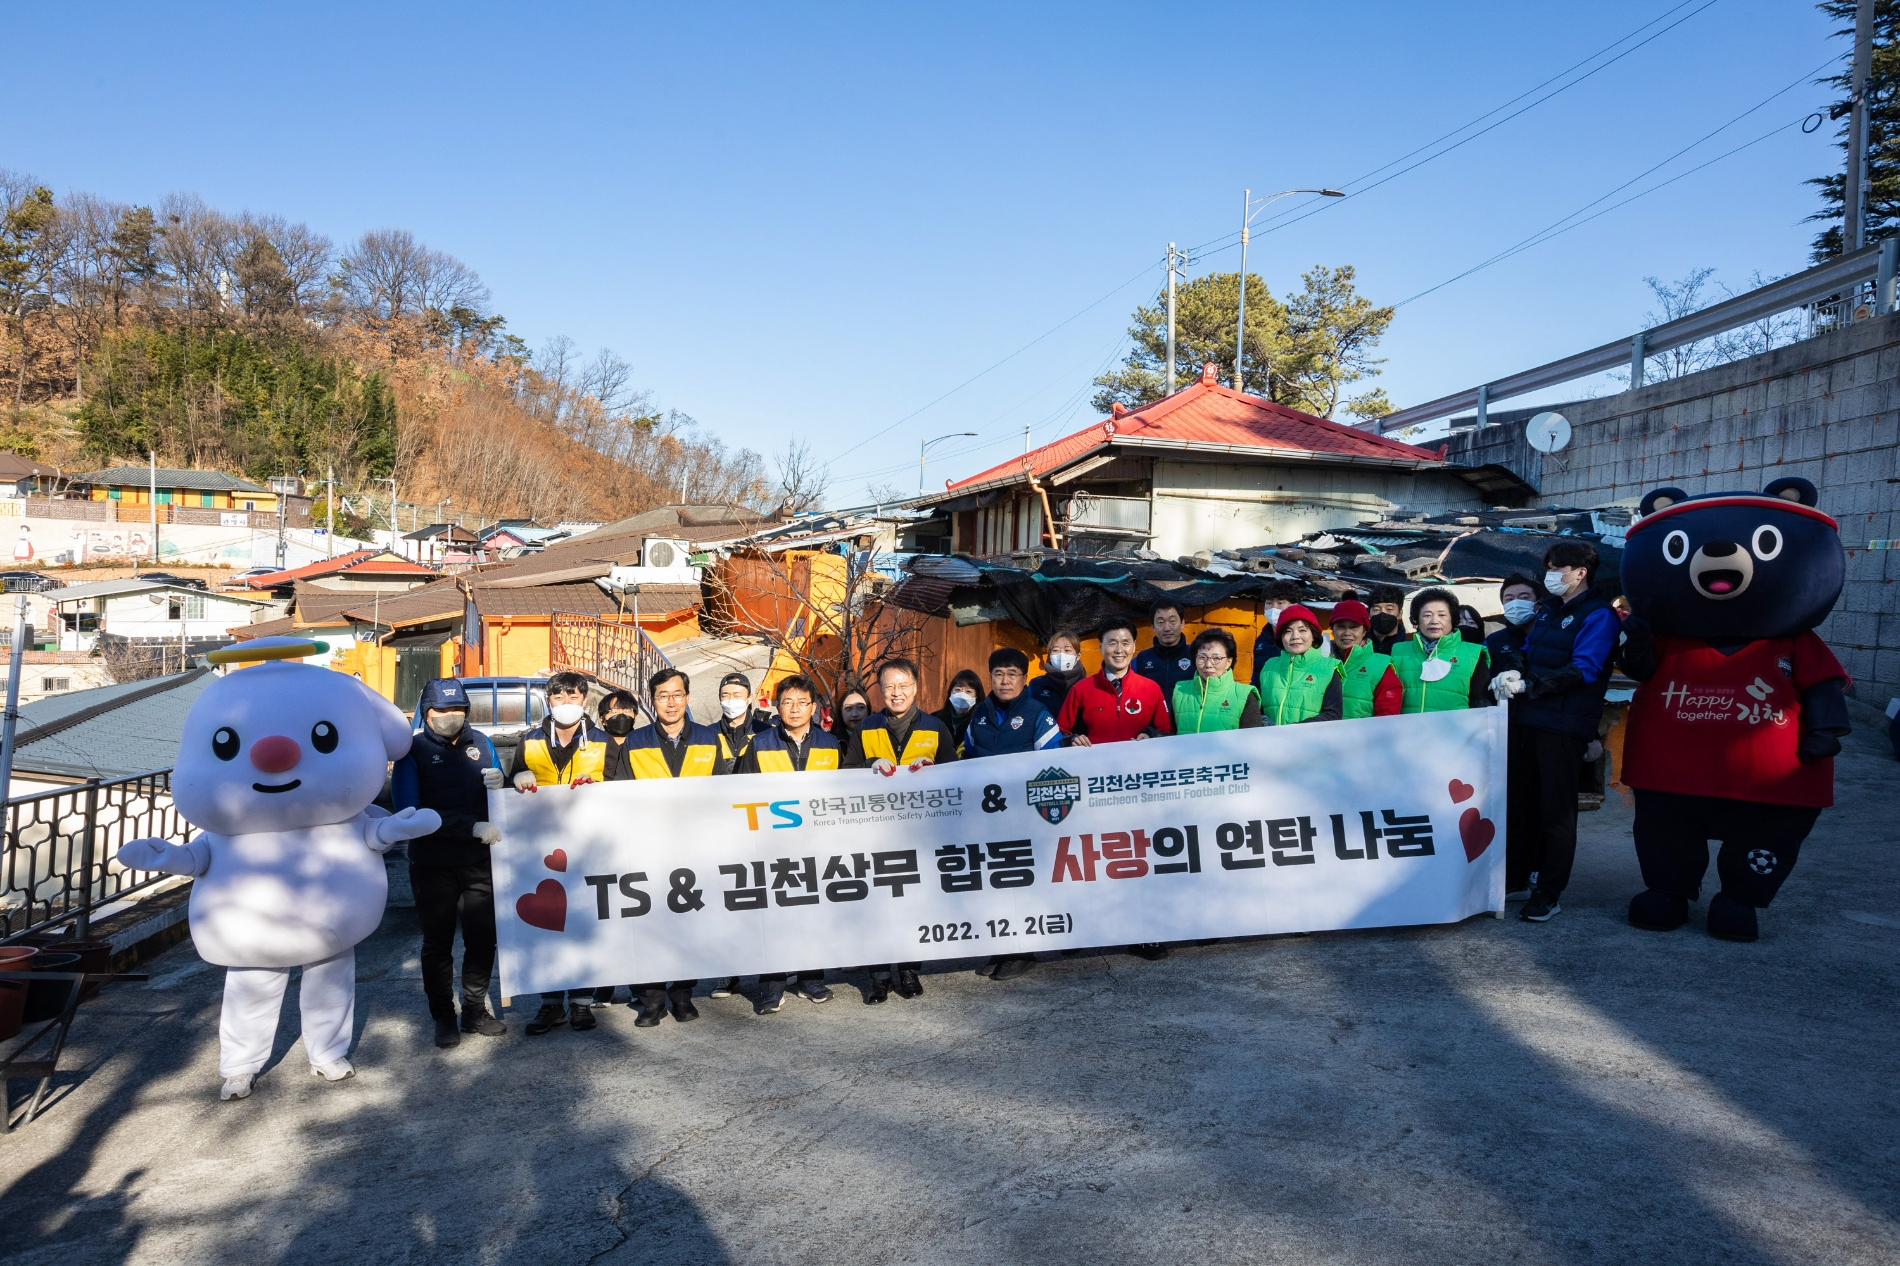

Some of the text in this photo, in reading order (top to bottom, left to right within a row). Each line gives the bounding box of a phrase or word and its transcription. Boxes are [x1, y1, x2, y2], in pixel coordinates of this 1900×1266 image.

[1661, 681, 1734, 710] Happy
[1676, 702, 1788, 725] together 김천
[732, 762, 1250, 831] TS 한국교통안전공단 & 김천상무프로축구단
[1028, 784, 1080, 805] 김천상무
[1088, 782, 1250, 808] Gimcheon Sangmu Football Club
[813, 807, 963, 827] Korea Transportation Safety Authority
[584, 808, 1436, 921] TS & 김천상무 합동 사랑의 연탄 나눔
[918, 912, 1073, 944] 2022. 12. 2(금)
